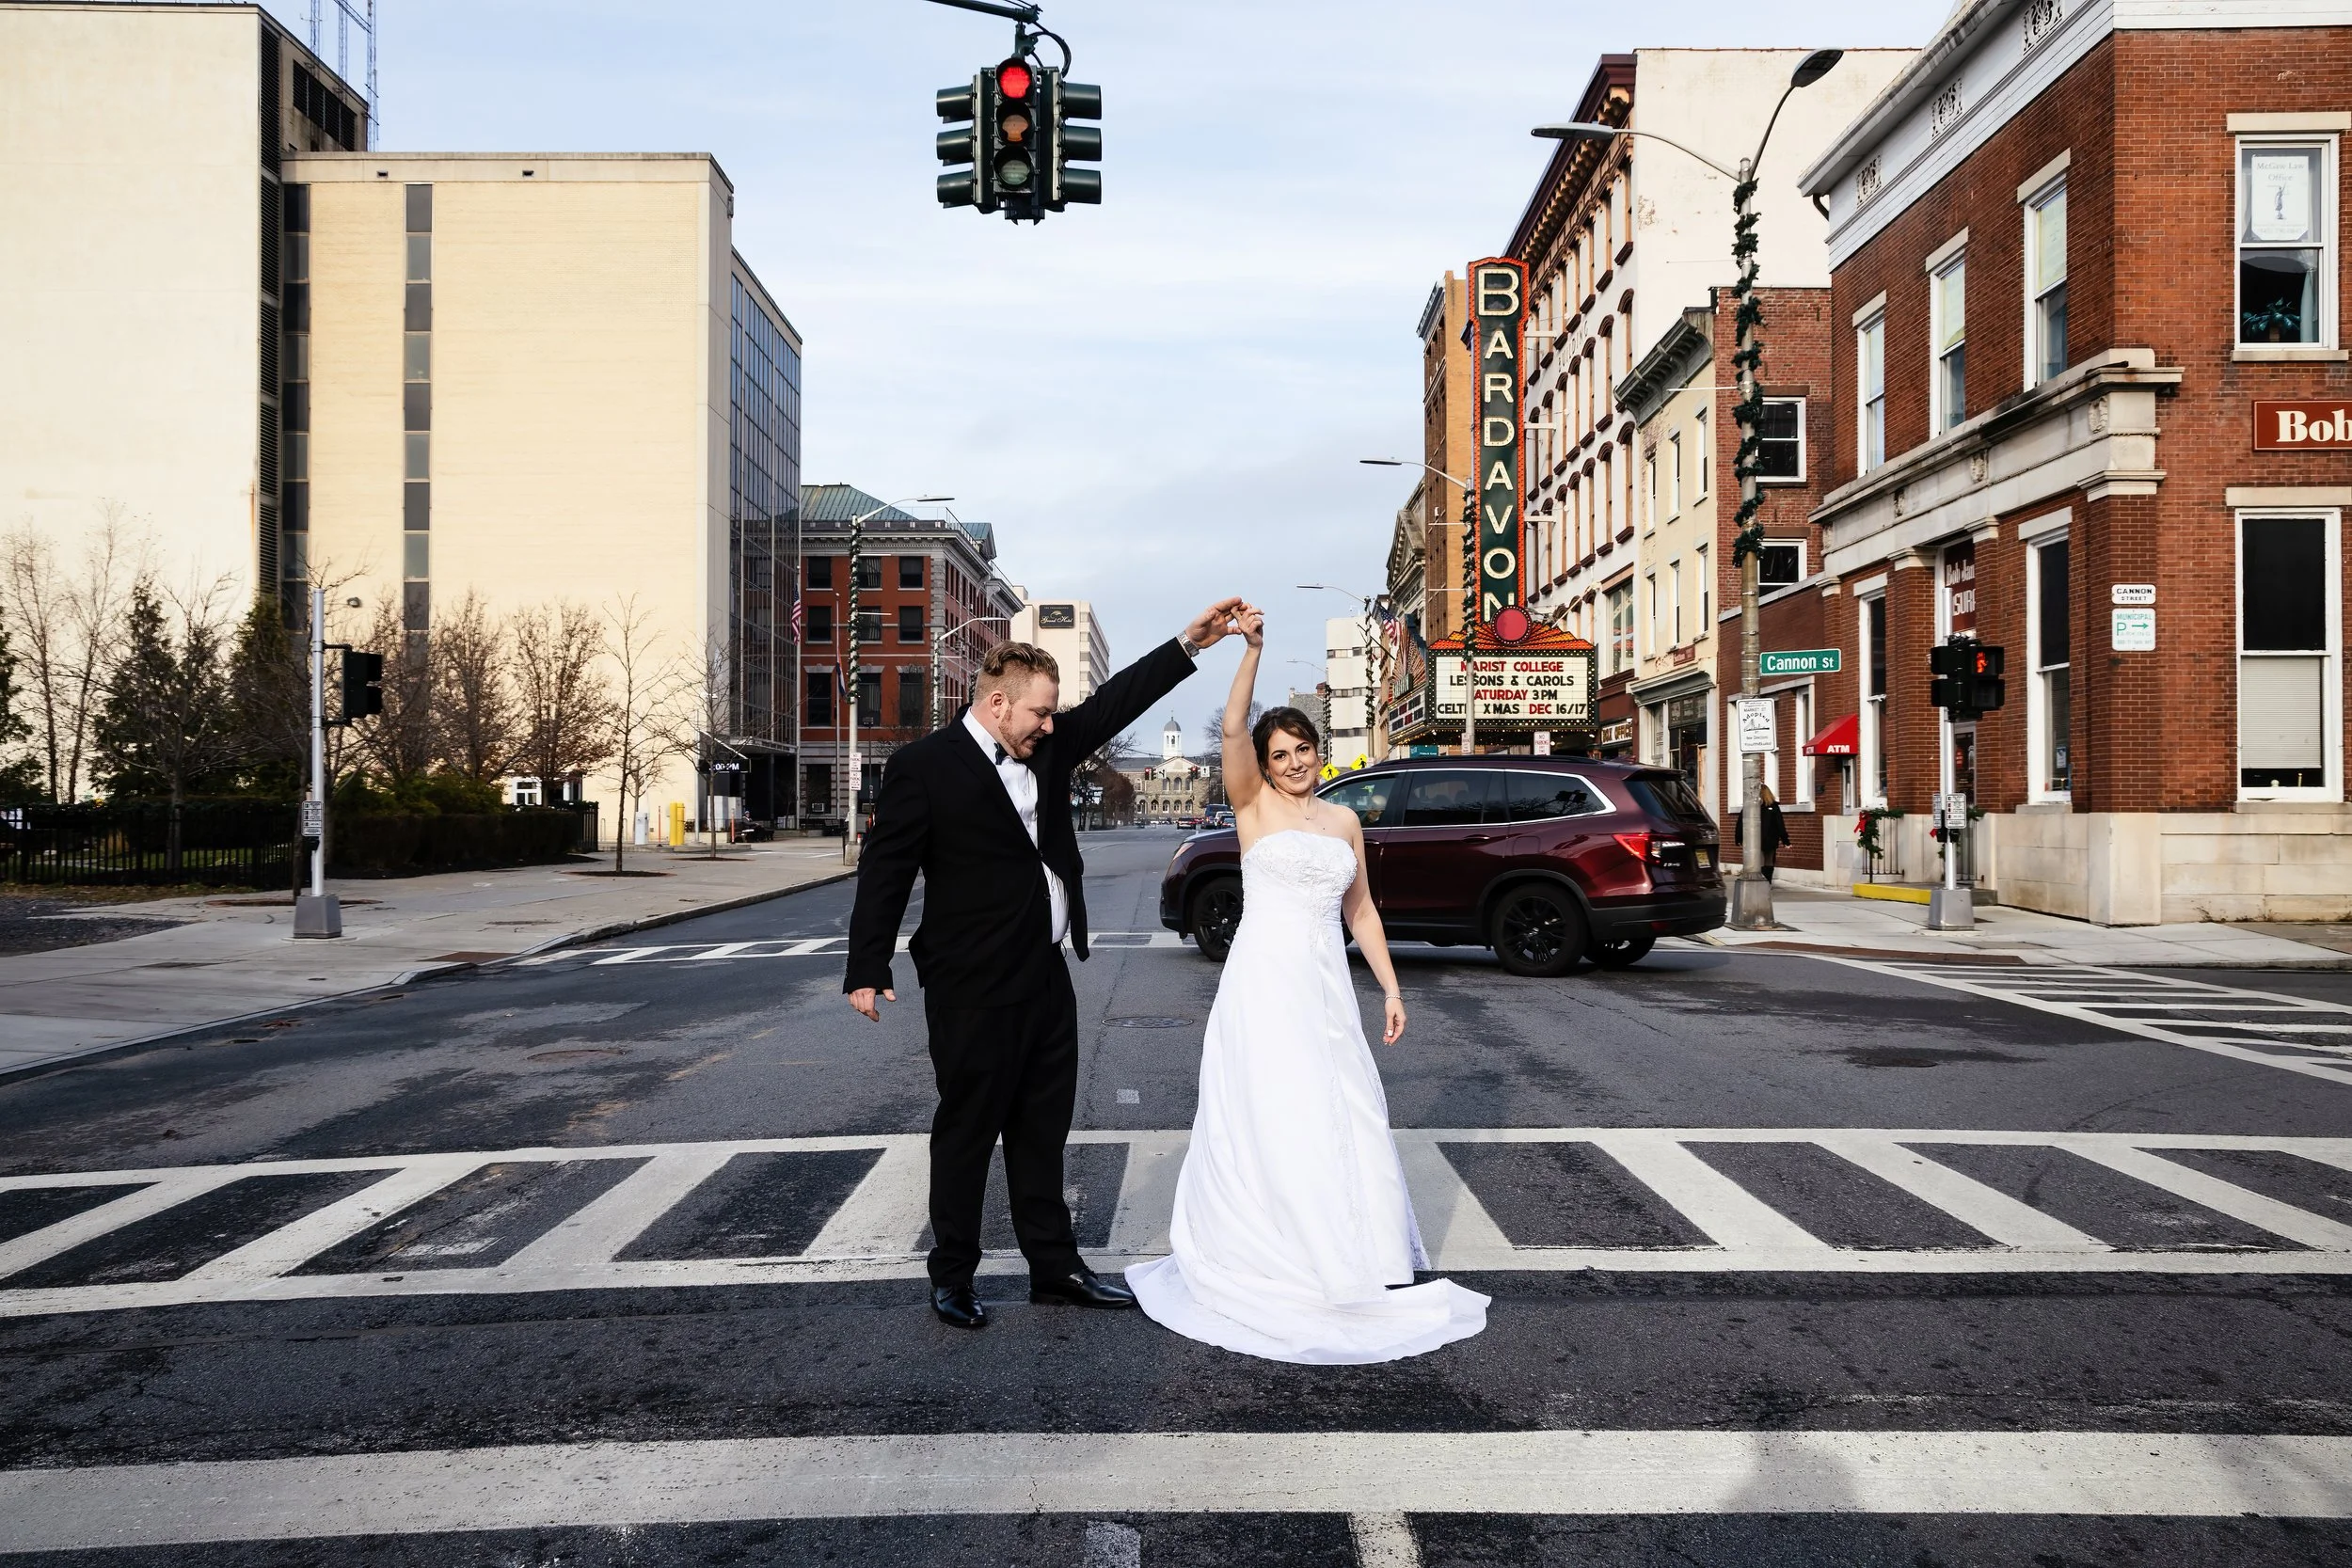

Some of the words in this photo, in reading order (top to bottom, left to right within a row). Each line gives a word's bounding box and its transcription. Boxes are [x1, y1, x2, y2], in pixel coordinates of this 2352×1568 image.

[2275, 408, 2352, 443] Bob
[1477, 266, 1520, 625] BARDAVON
[1946, 562, 1961, 587] Bob
[1513, 661, 1565, 672] COLLEGE
[1767, 656, 1817, 671] Cannon
[1821, 657, 1835, 669] St
[1450, 675, 1504, 686] LESONS
[1510, 675, 1518, 686] &
[1526, 675, 1574, 686] CAROLS
[1473, 689, 1529, 700] ATURDAY
[1437, 704, 1467, 714] CELTI
[1529, 704, 1552, 714] DEC
[1555, 704, 1586, 715] 16/17
[1826, 744, 1851, 753] ATM
